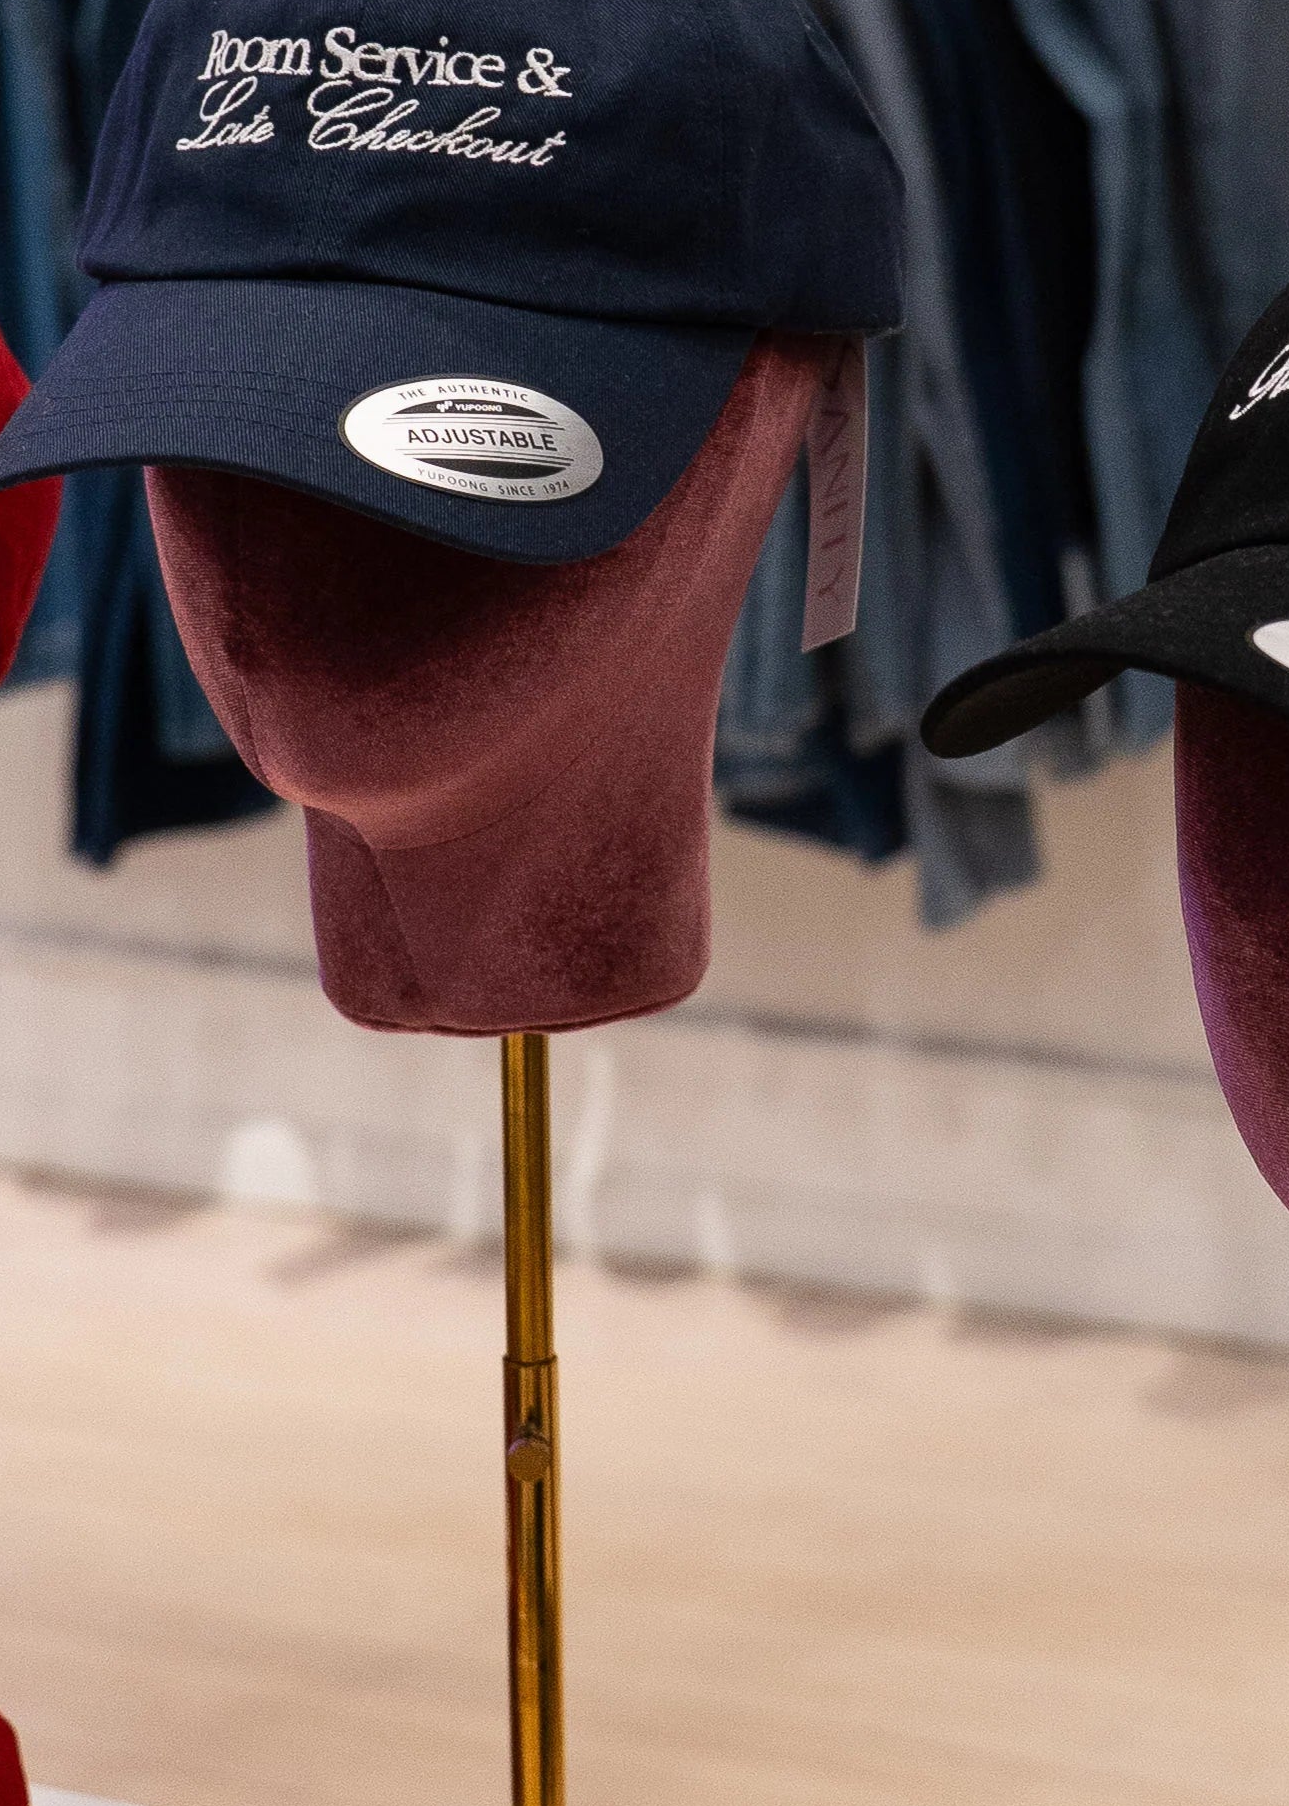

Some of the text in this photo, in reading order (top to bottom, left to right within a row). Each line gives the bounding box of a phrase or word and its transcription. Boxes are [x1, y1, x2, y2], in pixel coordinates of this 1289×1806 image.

[198, 26, 573, 98] Room Service &
[176, 76, 567, 167] Late Checkout
[397, 384, 529, 403] THE AUTHENTIC
[454, 403, 503, 413] YUPOONG
[407, 428, 559, 453] ADJUSTABLE
[417, 467, 571, 496] YUPOONG SINCE 1974
